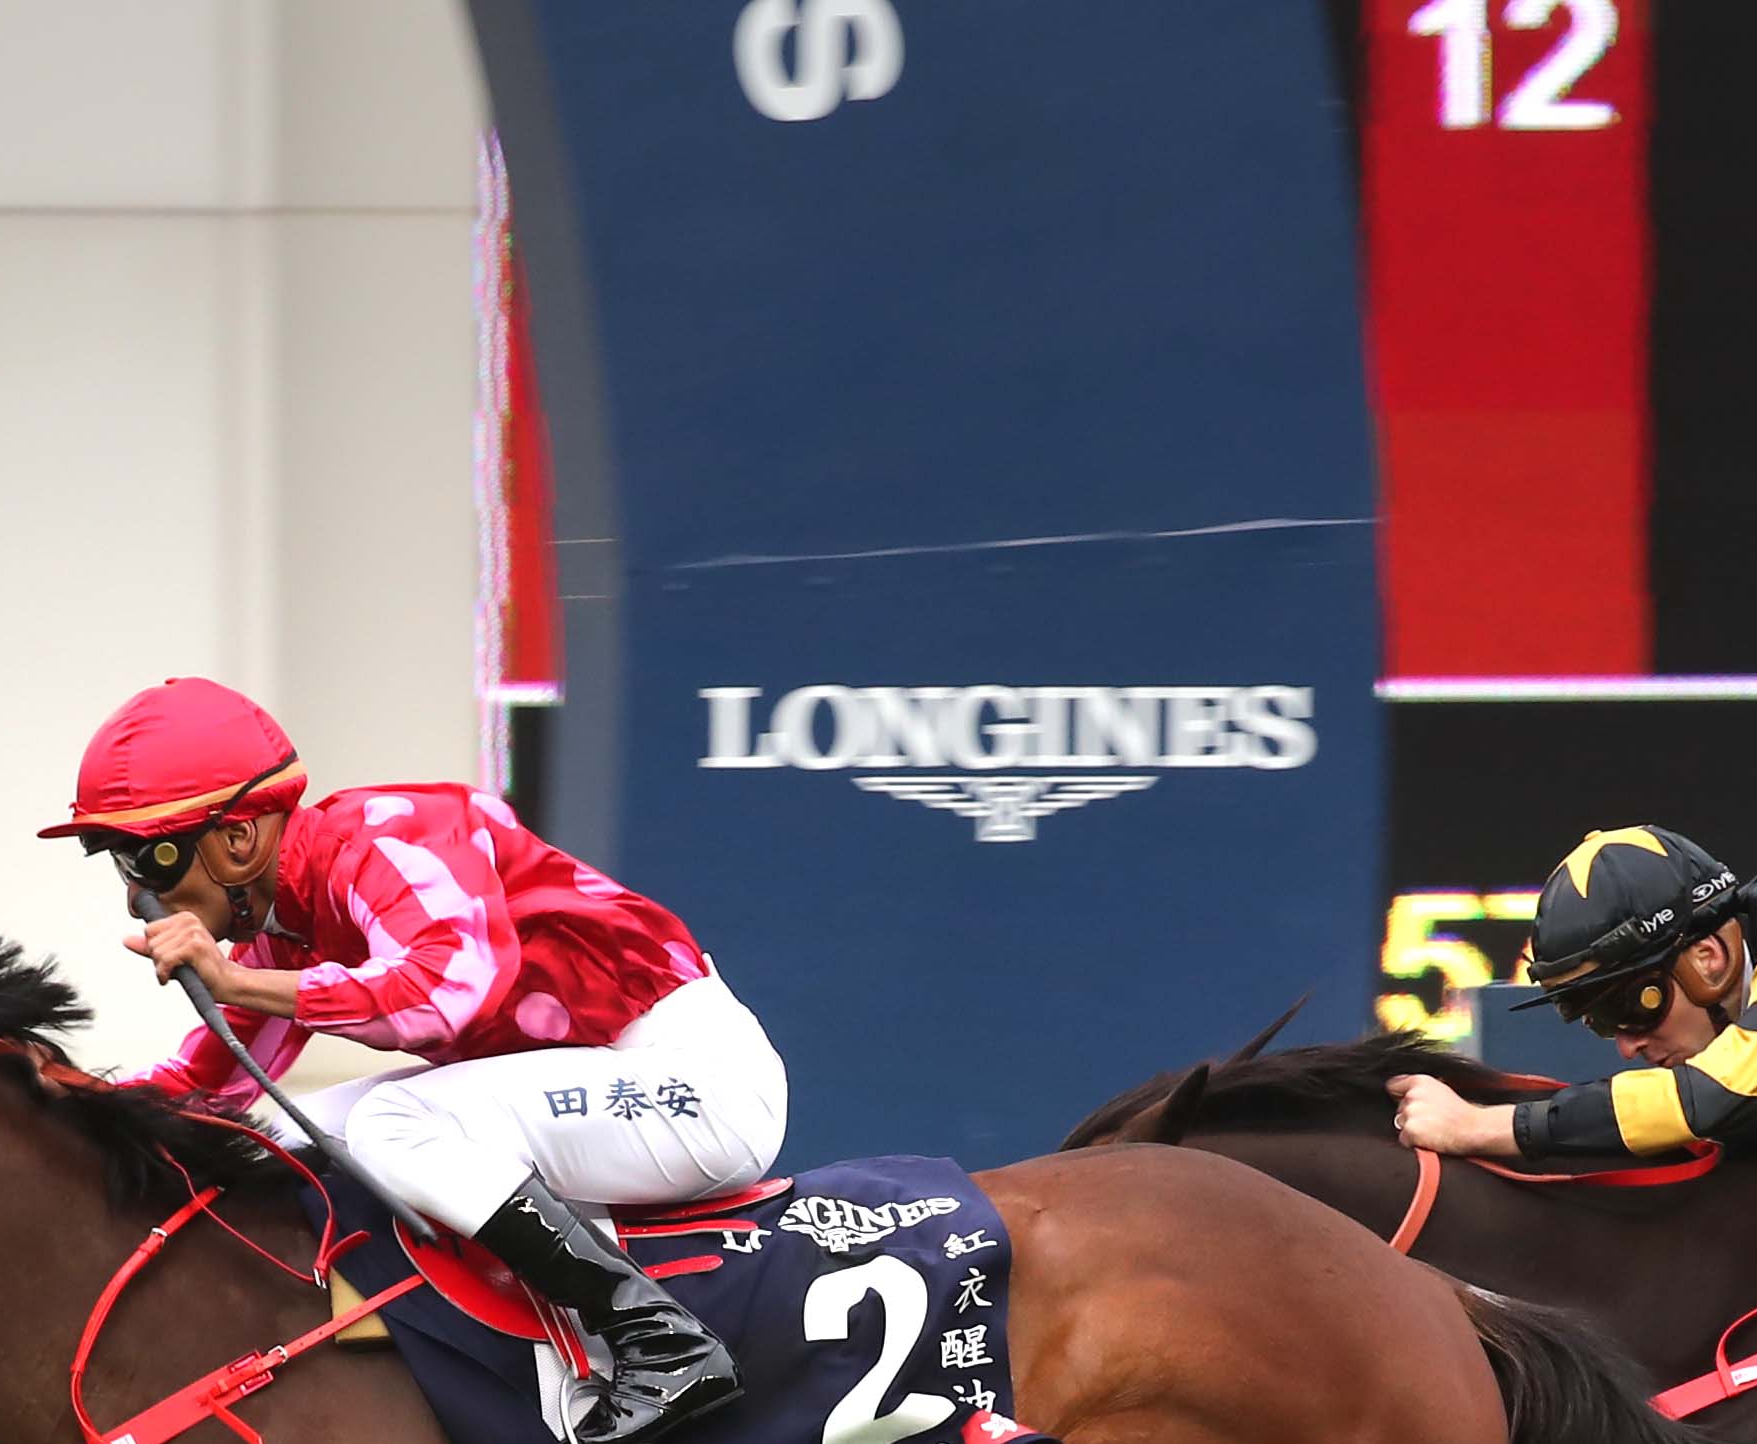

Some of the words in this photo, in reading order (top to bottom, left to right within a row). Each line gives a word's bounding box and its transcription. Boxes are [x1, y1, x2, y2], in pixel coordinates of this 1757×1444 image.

[1407, 0, 1621, 130] 12
[697, 684, 1318, 770] LONGINES
[1642, 908, 1675, 934] lyle
[544, 1077, 702, 1121] 田泰安
